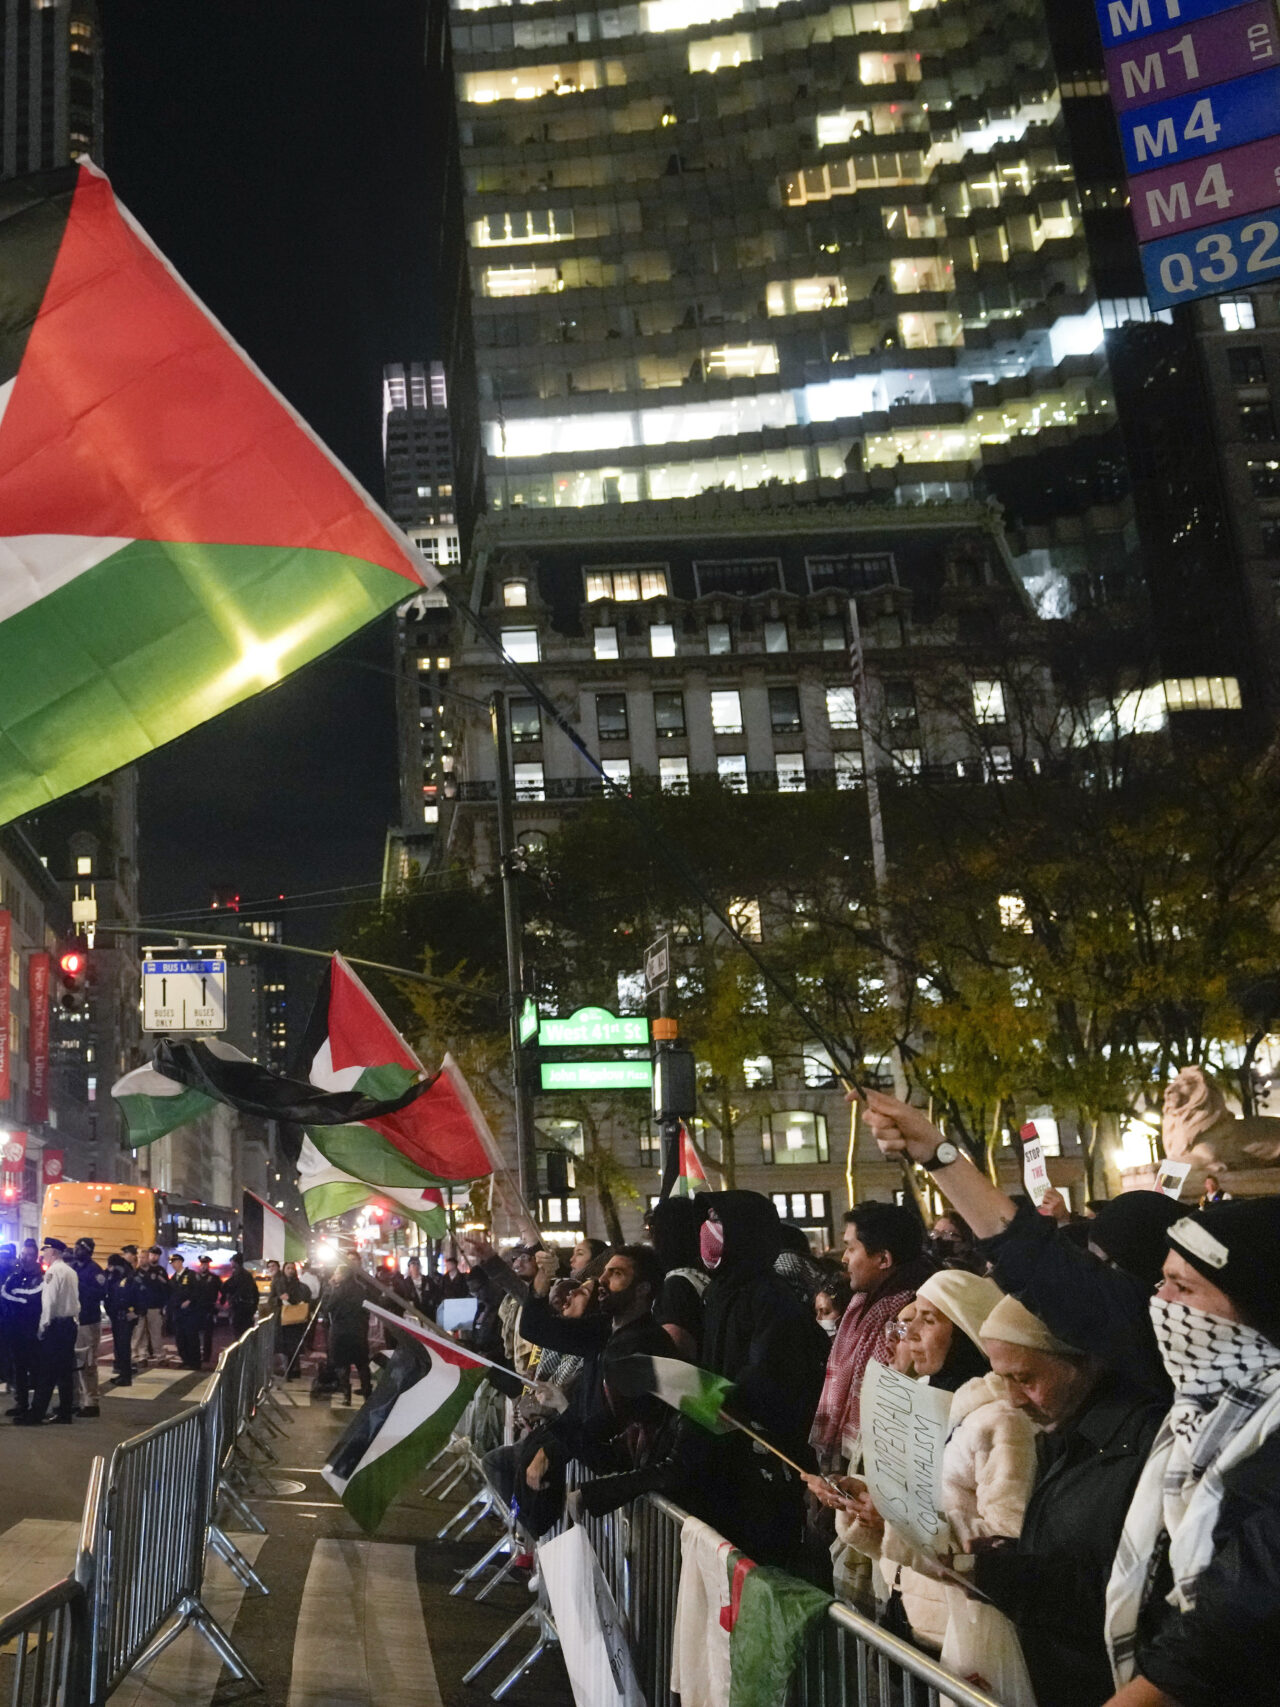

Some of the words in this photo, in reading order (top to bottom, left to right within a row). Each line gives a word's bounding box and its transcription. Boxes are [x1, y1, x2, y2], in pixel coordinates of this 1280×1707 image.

[1247, 23, 1273, 61] LTD
[1121, 34, 1200, 98] M1
[1133, 98, 1221, 162] M4
[1145, 162, 1234, 228] M4
[1160, 220, 1280, 294] Q32
[162, 963, 178, 972] BUS
[180, 963, 205, 972] LANES
[154, 1009, 175, 1017] BUSES
[194, 1009, 215, 1017] BUSES
[546, 1024, 588, 1041] West
[591, 1021, 620, 1040] 41st
[623, 1022, 642, 1040] St
[32, 1055, 45, 1097] Library
[550, 1068, 576, 1082] John
[1024, 1147, 1041, 1162] STOP
[1032, 1165, 1044, 1179] THE
[873, 1364, 918, 1493] IMPERIALISM
[914, 1414, 942, 1536] COLONIALISM
